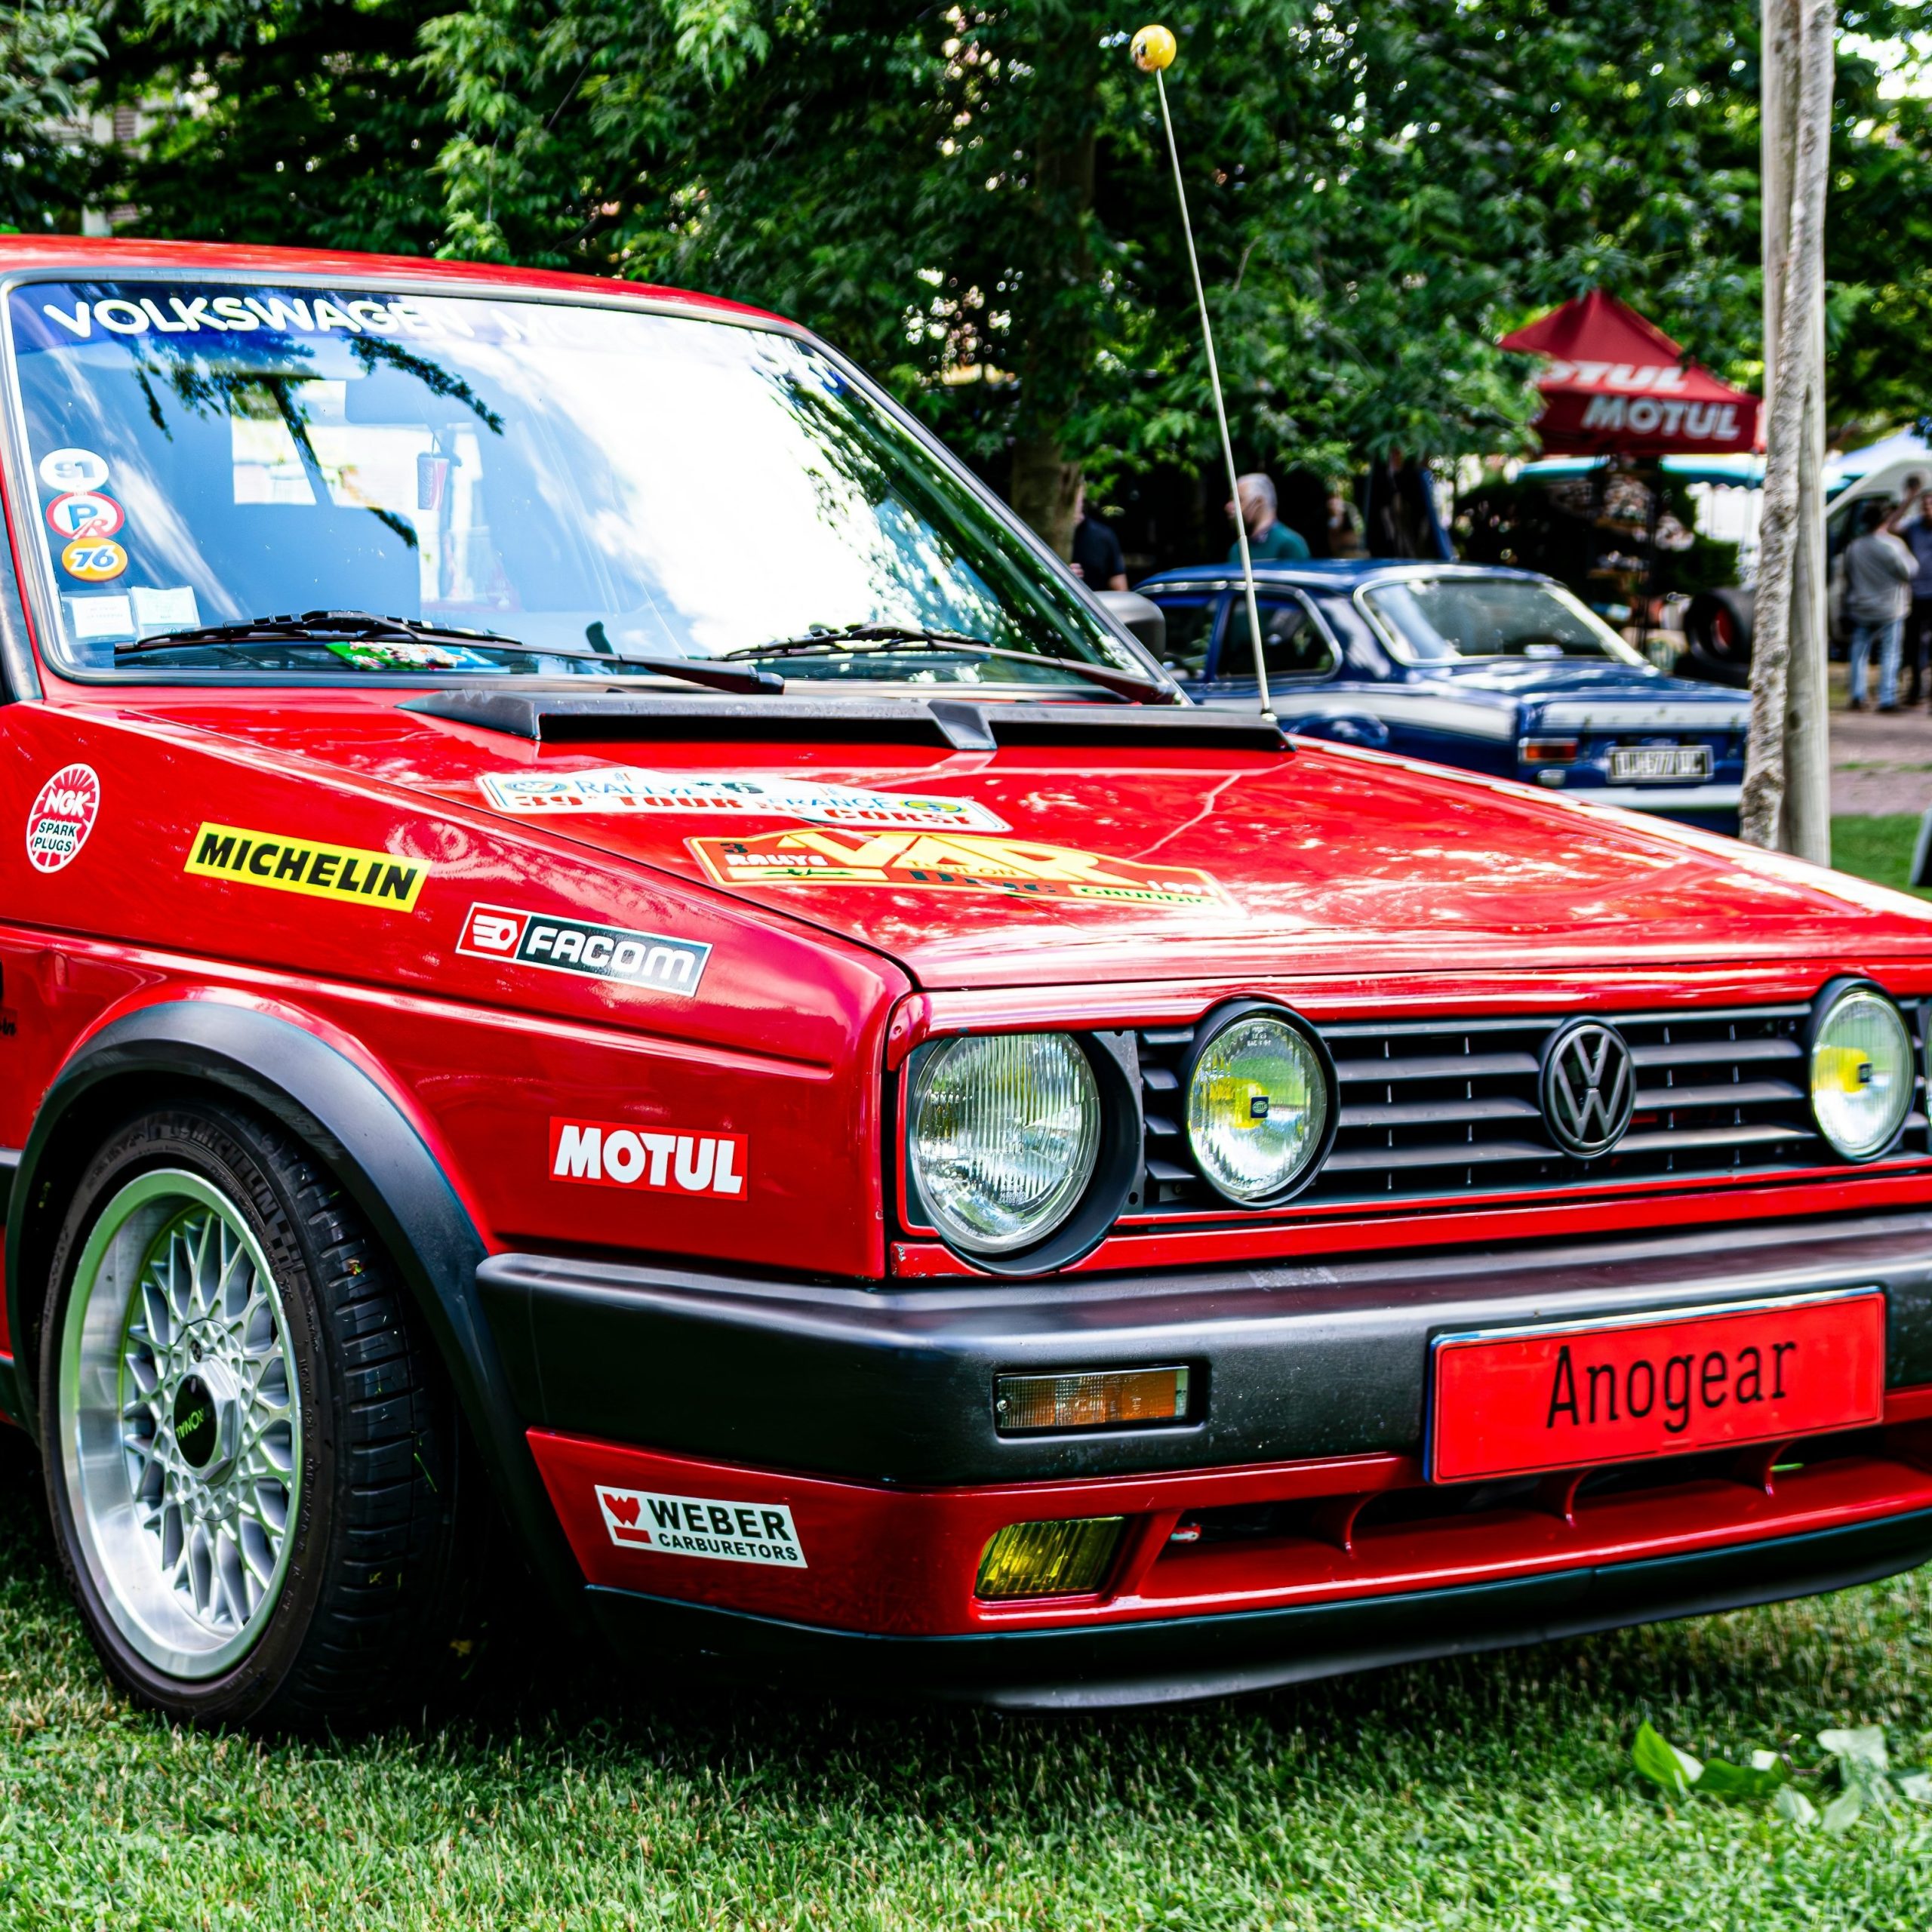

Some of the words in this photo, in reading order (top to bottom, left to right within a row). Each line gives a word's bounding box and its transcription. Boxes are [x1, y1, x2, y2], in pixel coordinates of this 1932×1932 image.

[44, 297, 474, 337] VOLKSWAGEN
[1580, 395, 1741, 441] MOTUL
[74, 548, 115, 568] 76
[43, 788, 91, 817] NGK
[611, 795, 744, 808] TOUR
[38, 821, 76, 838] SPARK
[34, 837, 72, 853] PLUGS
[720, 842, 749, 854] 3
[196, 834, 417, 901] MICHELIN
[553, 1124, 743, 1194] MOTUL
[1546, 1340, 1797, 1433] Anogear
[647, 1498, 792, 1542] WEBER
[657, 1532, 798, 1561] CARBURETORS
